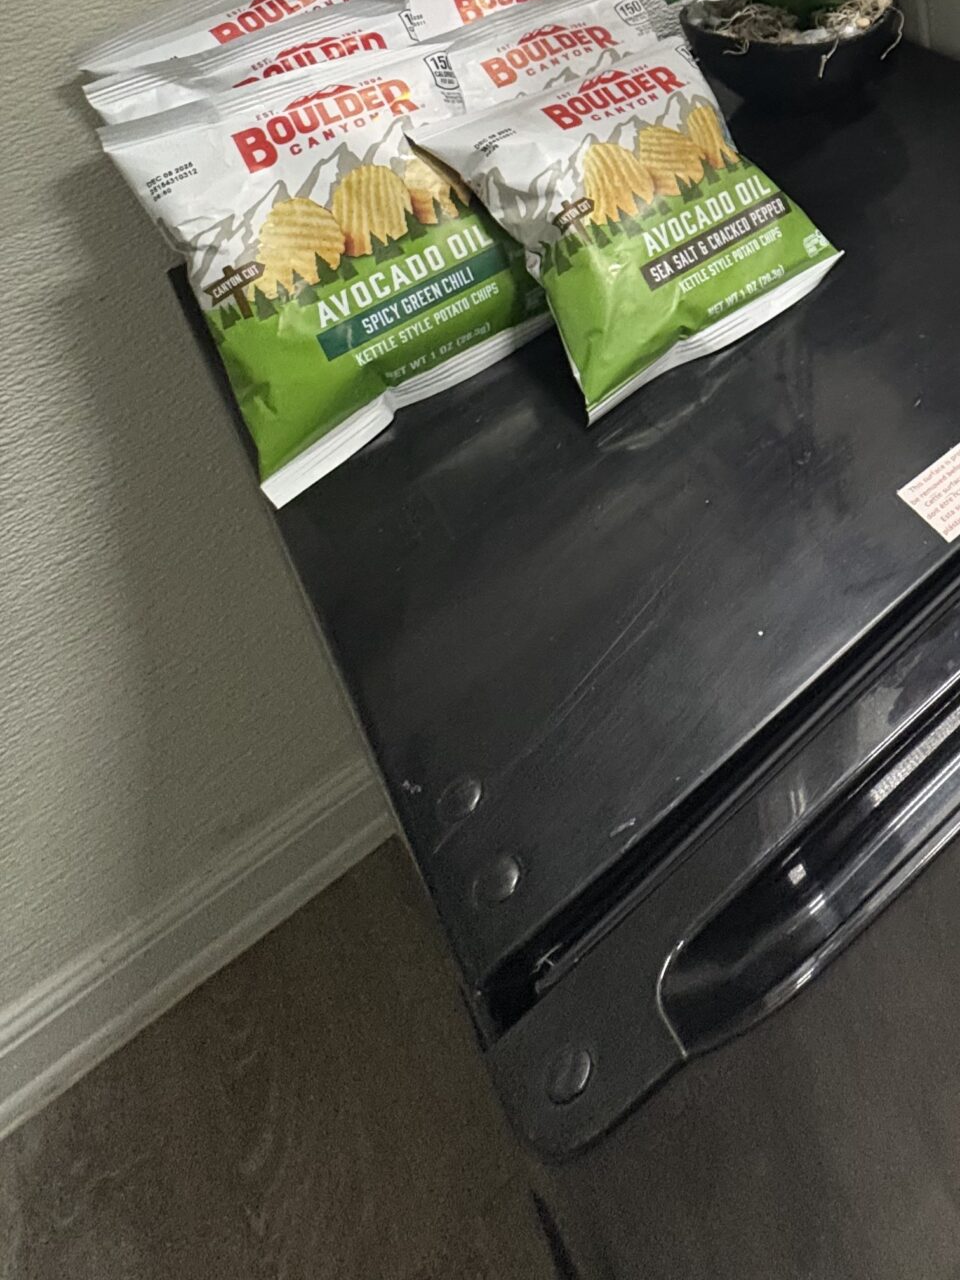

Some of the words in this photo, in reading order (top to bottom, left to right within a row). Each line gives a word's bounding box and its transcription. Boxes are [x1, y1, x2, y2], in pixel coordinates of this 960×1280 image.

[619, 0, 643, 18] 150
[232, 32, 387, 88] OULDER
[480, 25, 619, 89] BOULDER
[526, 46, 593, 77] CANYON
[231, 79, 419, 174] BOULDER
[541, 66, 686, 131] BOULDER
[590, 92, 660, 122] CANYON
[289, 112, 381, 156] CANYON
[642, 191, 736, 257] AVOCADO
[735, 175, 771, 206] OIL
[650, 263, 674, 283] SEA
[673, 245, 699, 270] SALT
[698, 240, 709, 255] &
[707, 220, 752, 250] CRACKED
[749, 198, 786, 228] PEPPER
[212, 273, 244, 298] CANYON
[241, 264, 259, 280] CUT
[317, 245, 446, 328] AVOCADO
[447, 225, 494, 260] OIL
[678, 269, 710, 294] KETTLE
[708, 254, 734, 277] STYLE
[732, 240, 761, 266] POTATO
[760, 226, 783, 247] CHIPS
[355, 335, 398, 367] KETTLE
[399, 317, 433, 343] STYLE
[434, 297, 470, 325] POTATO
[471, 282, 499, 305] CHIPS
[361, 303, 401, 334] SPICY
[402, 285, 443, 315] GREEN
[442, 267, 475, 293] CHILI
[909, 481, 923, 492] This
[922, 463, 945, 482] surface
